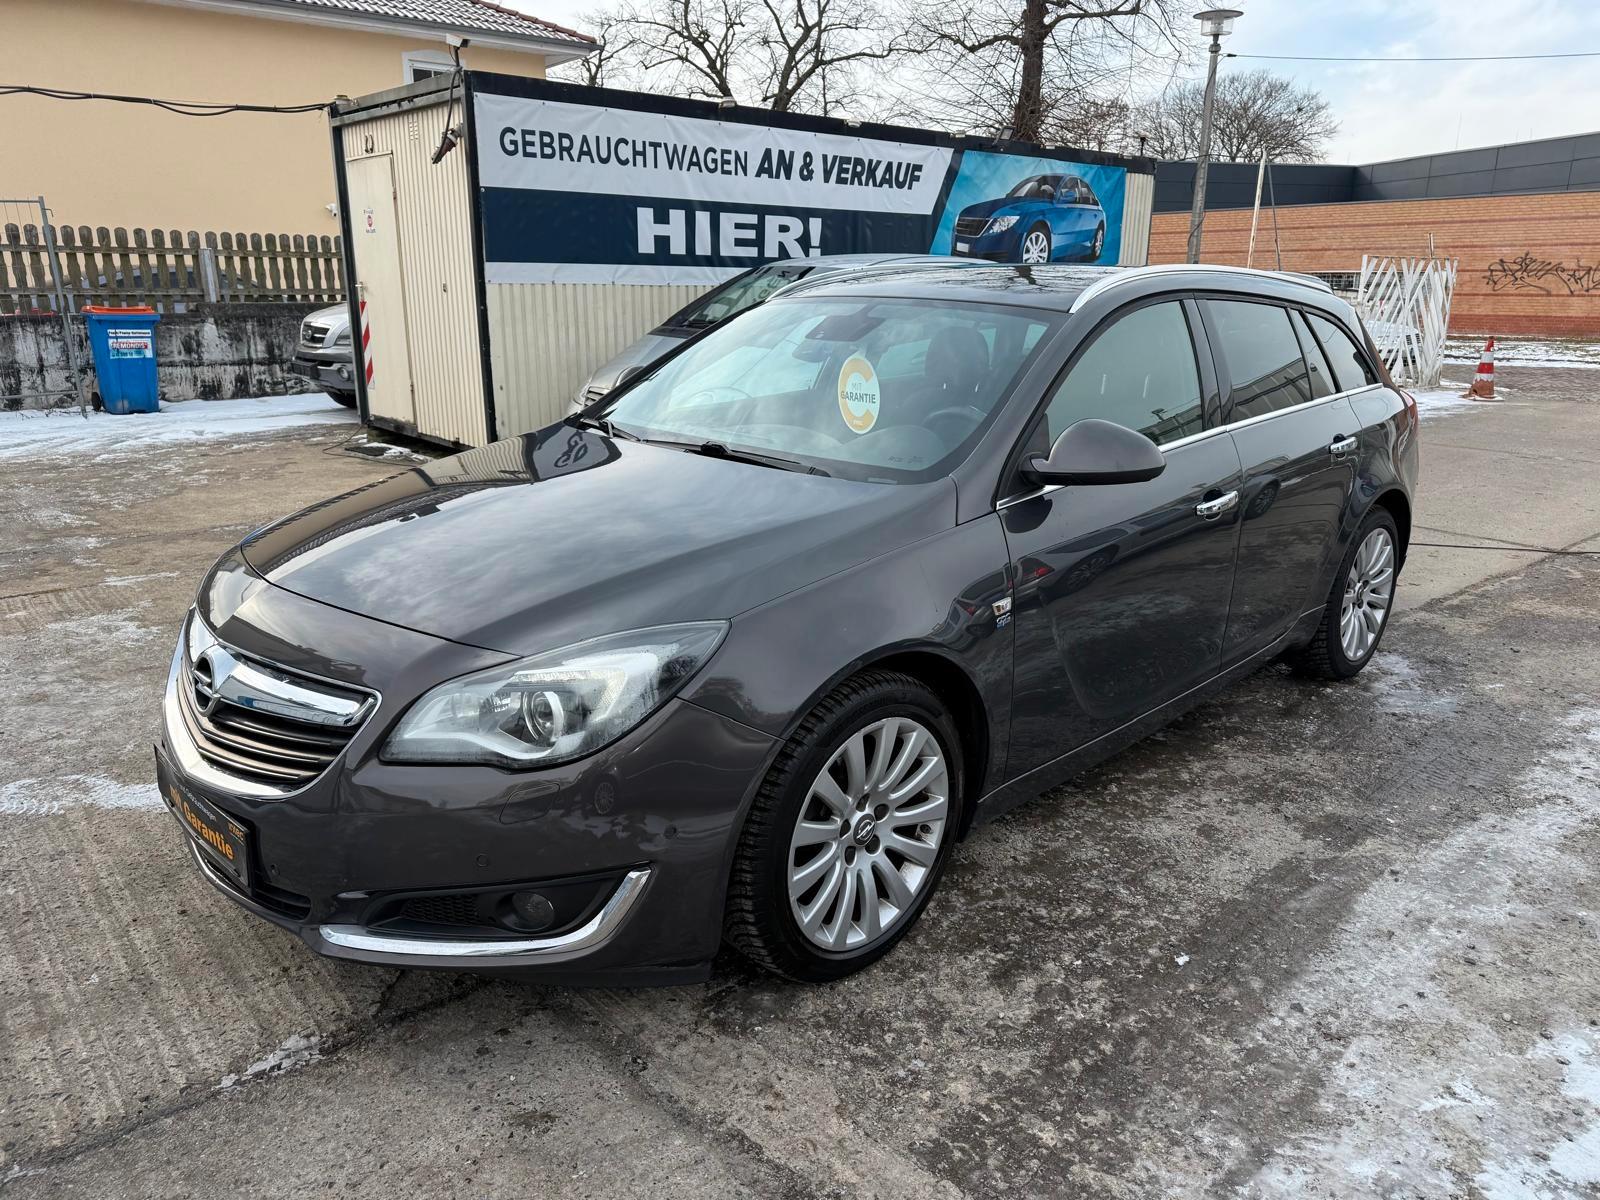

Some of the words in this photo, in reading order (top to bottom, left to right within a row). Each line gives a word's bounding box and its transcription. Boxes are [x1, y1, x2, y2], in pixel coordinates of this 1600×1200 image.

[499, 126, 748, 177] GEBRAUCHTWAGEN
[754, 147, 795, 181] AN
[799, 151, 815, 182] &
[821, 153, 923, 191] VERKAUF
[636, 206, 822, 258] HIER!
[840, 391, 876, 404] GARANTIE
[184, 801, 234, 860] Garantie
